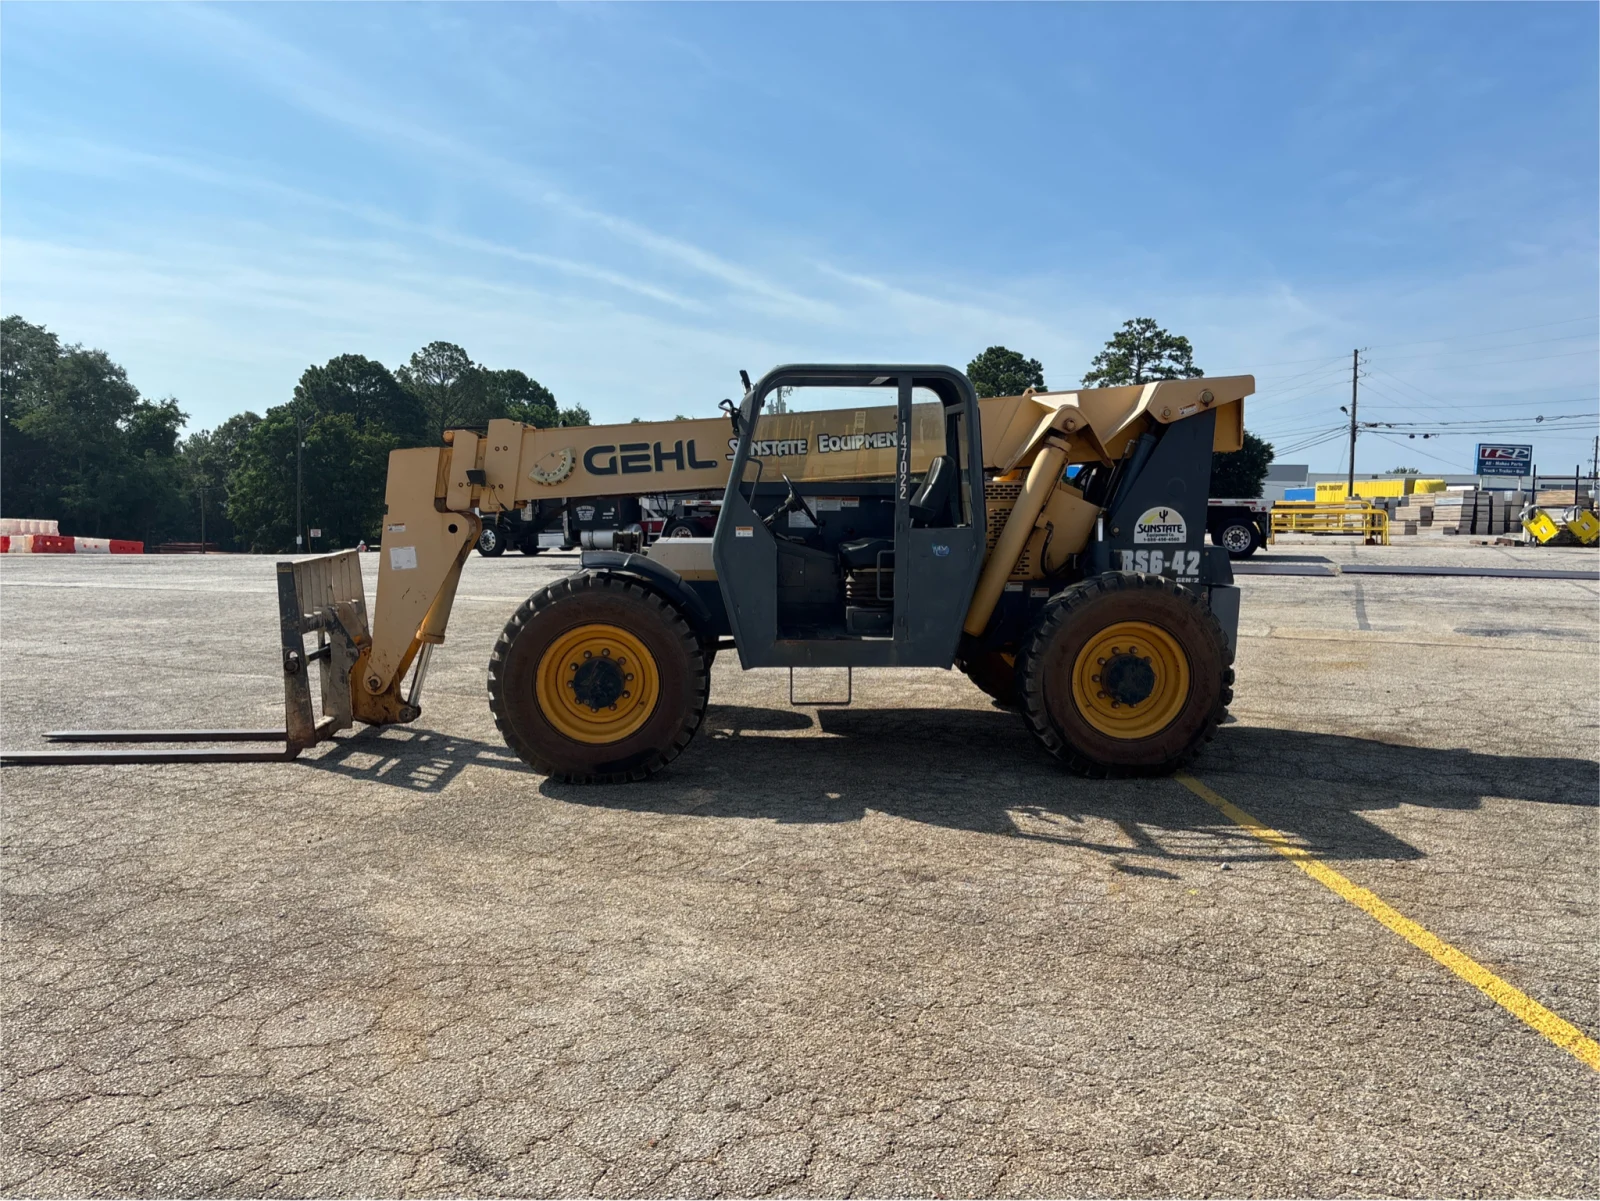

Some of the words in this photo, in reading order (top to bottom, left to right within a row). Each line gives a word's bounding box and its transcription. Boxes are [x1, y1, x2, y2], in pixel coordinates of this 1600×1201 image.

[583, 440, 718, 476] GEHL
[726, 438, 807, 461] SNSTATE
[899, 422, 908, 500] 147022
[1481, 447, 1529, 460] TRP
[1136, 523, 1184, 534] SUNSTATE
[1121, 549, 1200, 575] RS6-42
